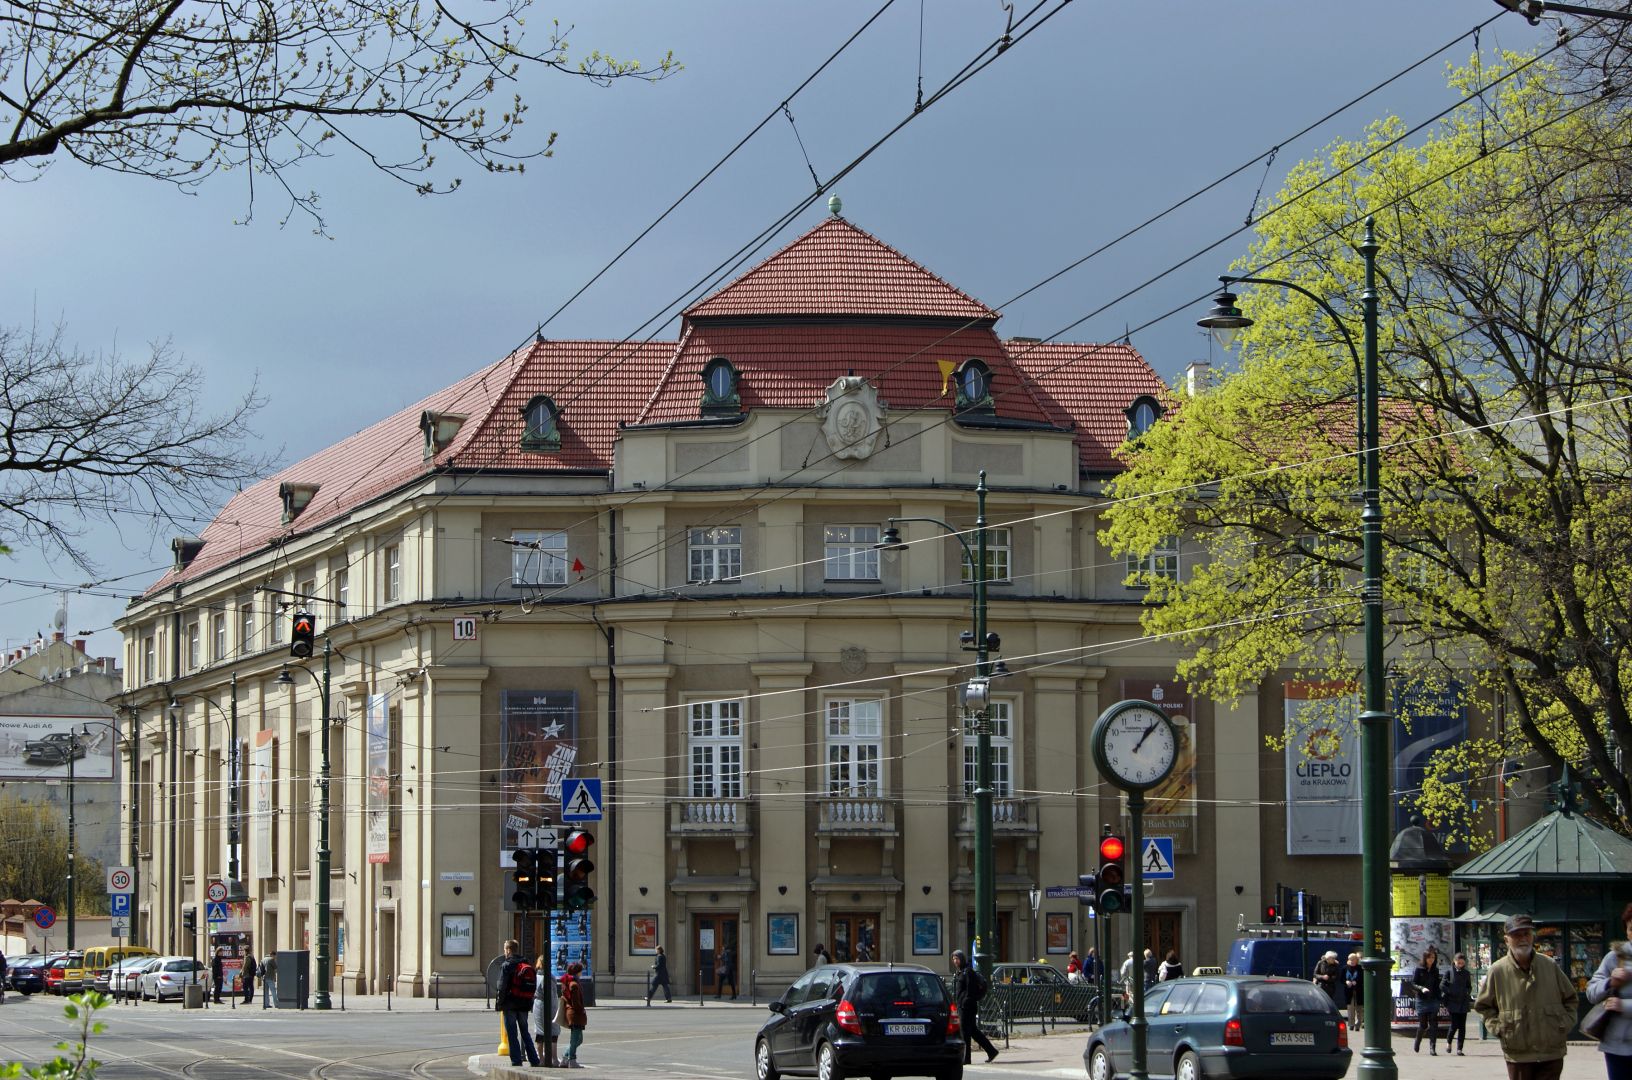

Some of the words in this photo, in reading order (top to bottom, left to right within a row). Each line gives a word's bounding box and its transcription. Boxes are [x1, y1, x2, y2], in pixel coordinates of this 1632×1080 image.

[457, 620, 473, 637] 10
[1121, 717, 1127, 726] 11
[1134, 713, 1142, 722] 12
[1111, 728, 1120, 737] 10
[1107, 742, 1114, 751] 9
[552, 744, 577, 763] ZIM
[1112, 756, 1119, 766] 8
[1123, 767, 1129, 776] 7
[1136, 770, 1142, 779] 6
[1296, 763, 1351, 777] CIEPŁO
[114, 875, 127, 885] 30
[115, 895, 127, 910] P
[889, 1025, 900, 1033] KR
[1275, 1033, 1293, 1043] KRA
